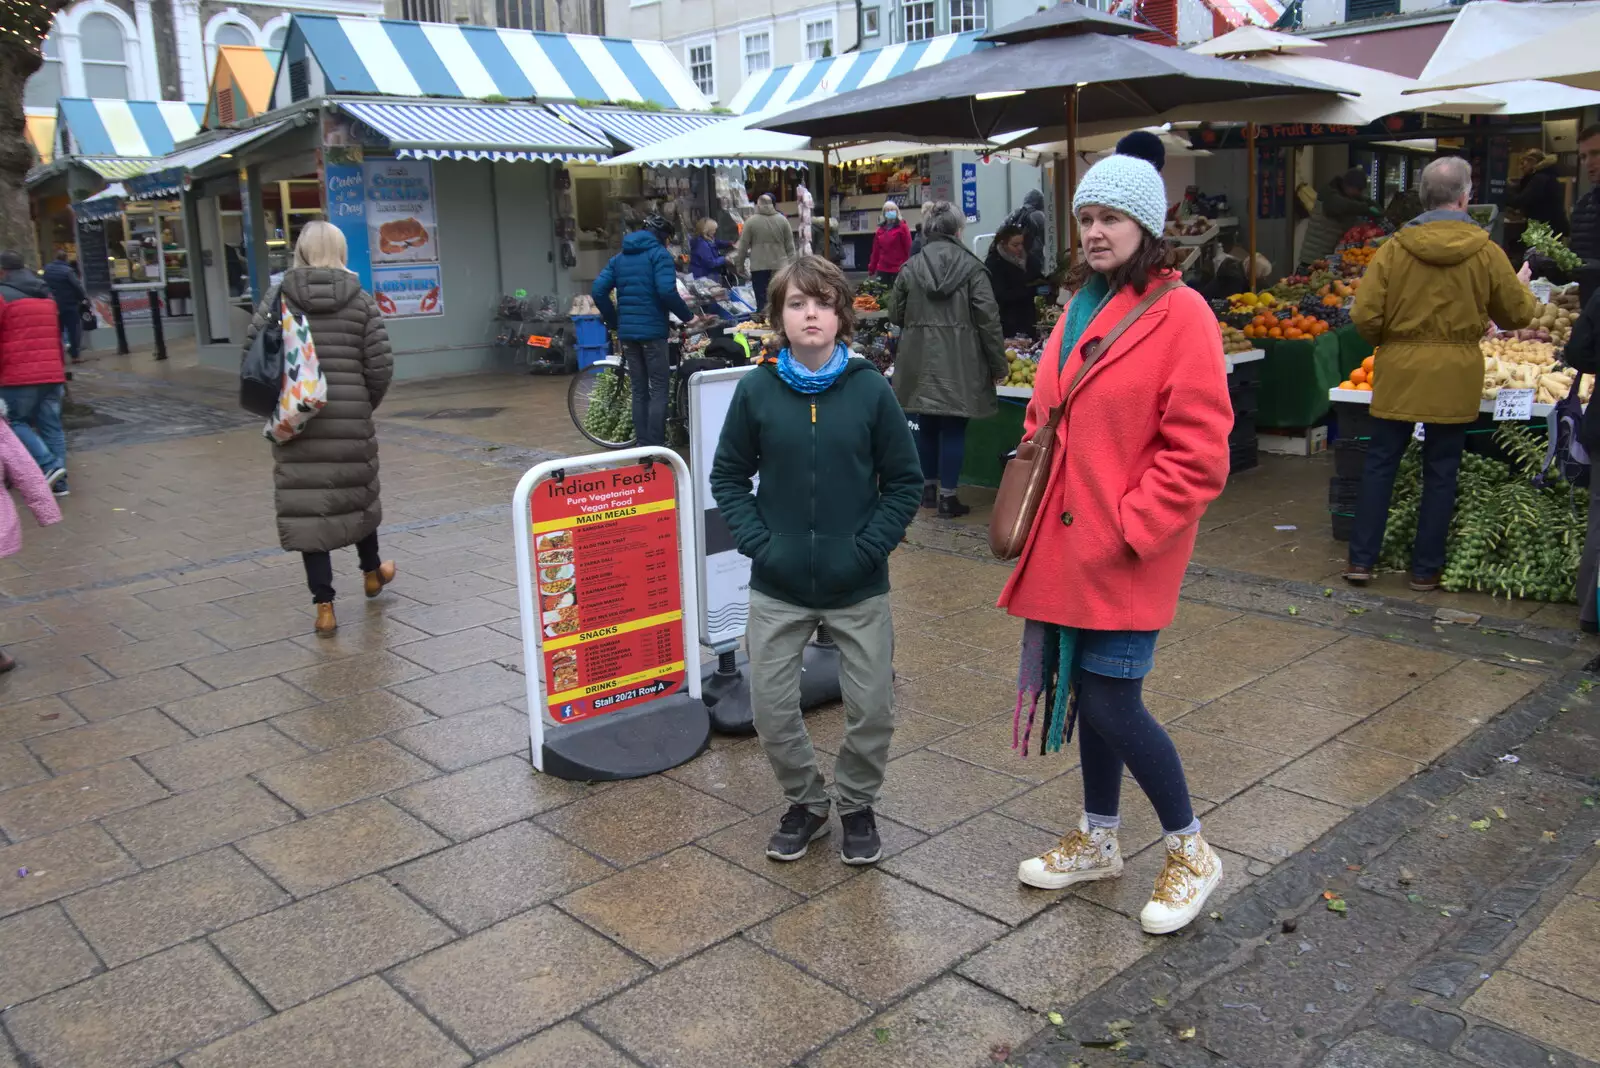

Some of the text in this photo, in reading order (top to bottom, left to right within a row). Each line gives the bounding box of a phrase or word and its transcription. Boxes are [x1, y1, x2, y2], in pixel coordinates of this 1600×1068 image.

[1272, 124, 1306, 138] Fruit
[1311, 124, 1324, 135] &
[329, 172, 363, 191] Catch
[338, 203, 363, 216] Day
[548, 469, 657, 498] Indian Feast
[567, 486, 645, 506] Pure Vegetarian &
[580, 497, 633, 513] Vegan Food
[576, 507, 637, 524] MAIN MEALS
[579, 626, 618, 641] SNACKS
[585, 680, 617, 694] DRINKS
[594, 696, 614, 708] Stall
[615, 690, 637, 702] 20/21
[638, 686, 656, 697] Row
[657, 683, 665, 691] A
